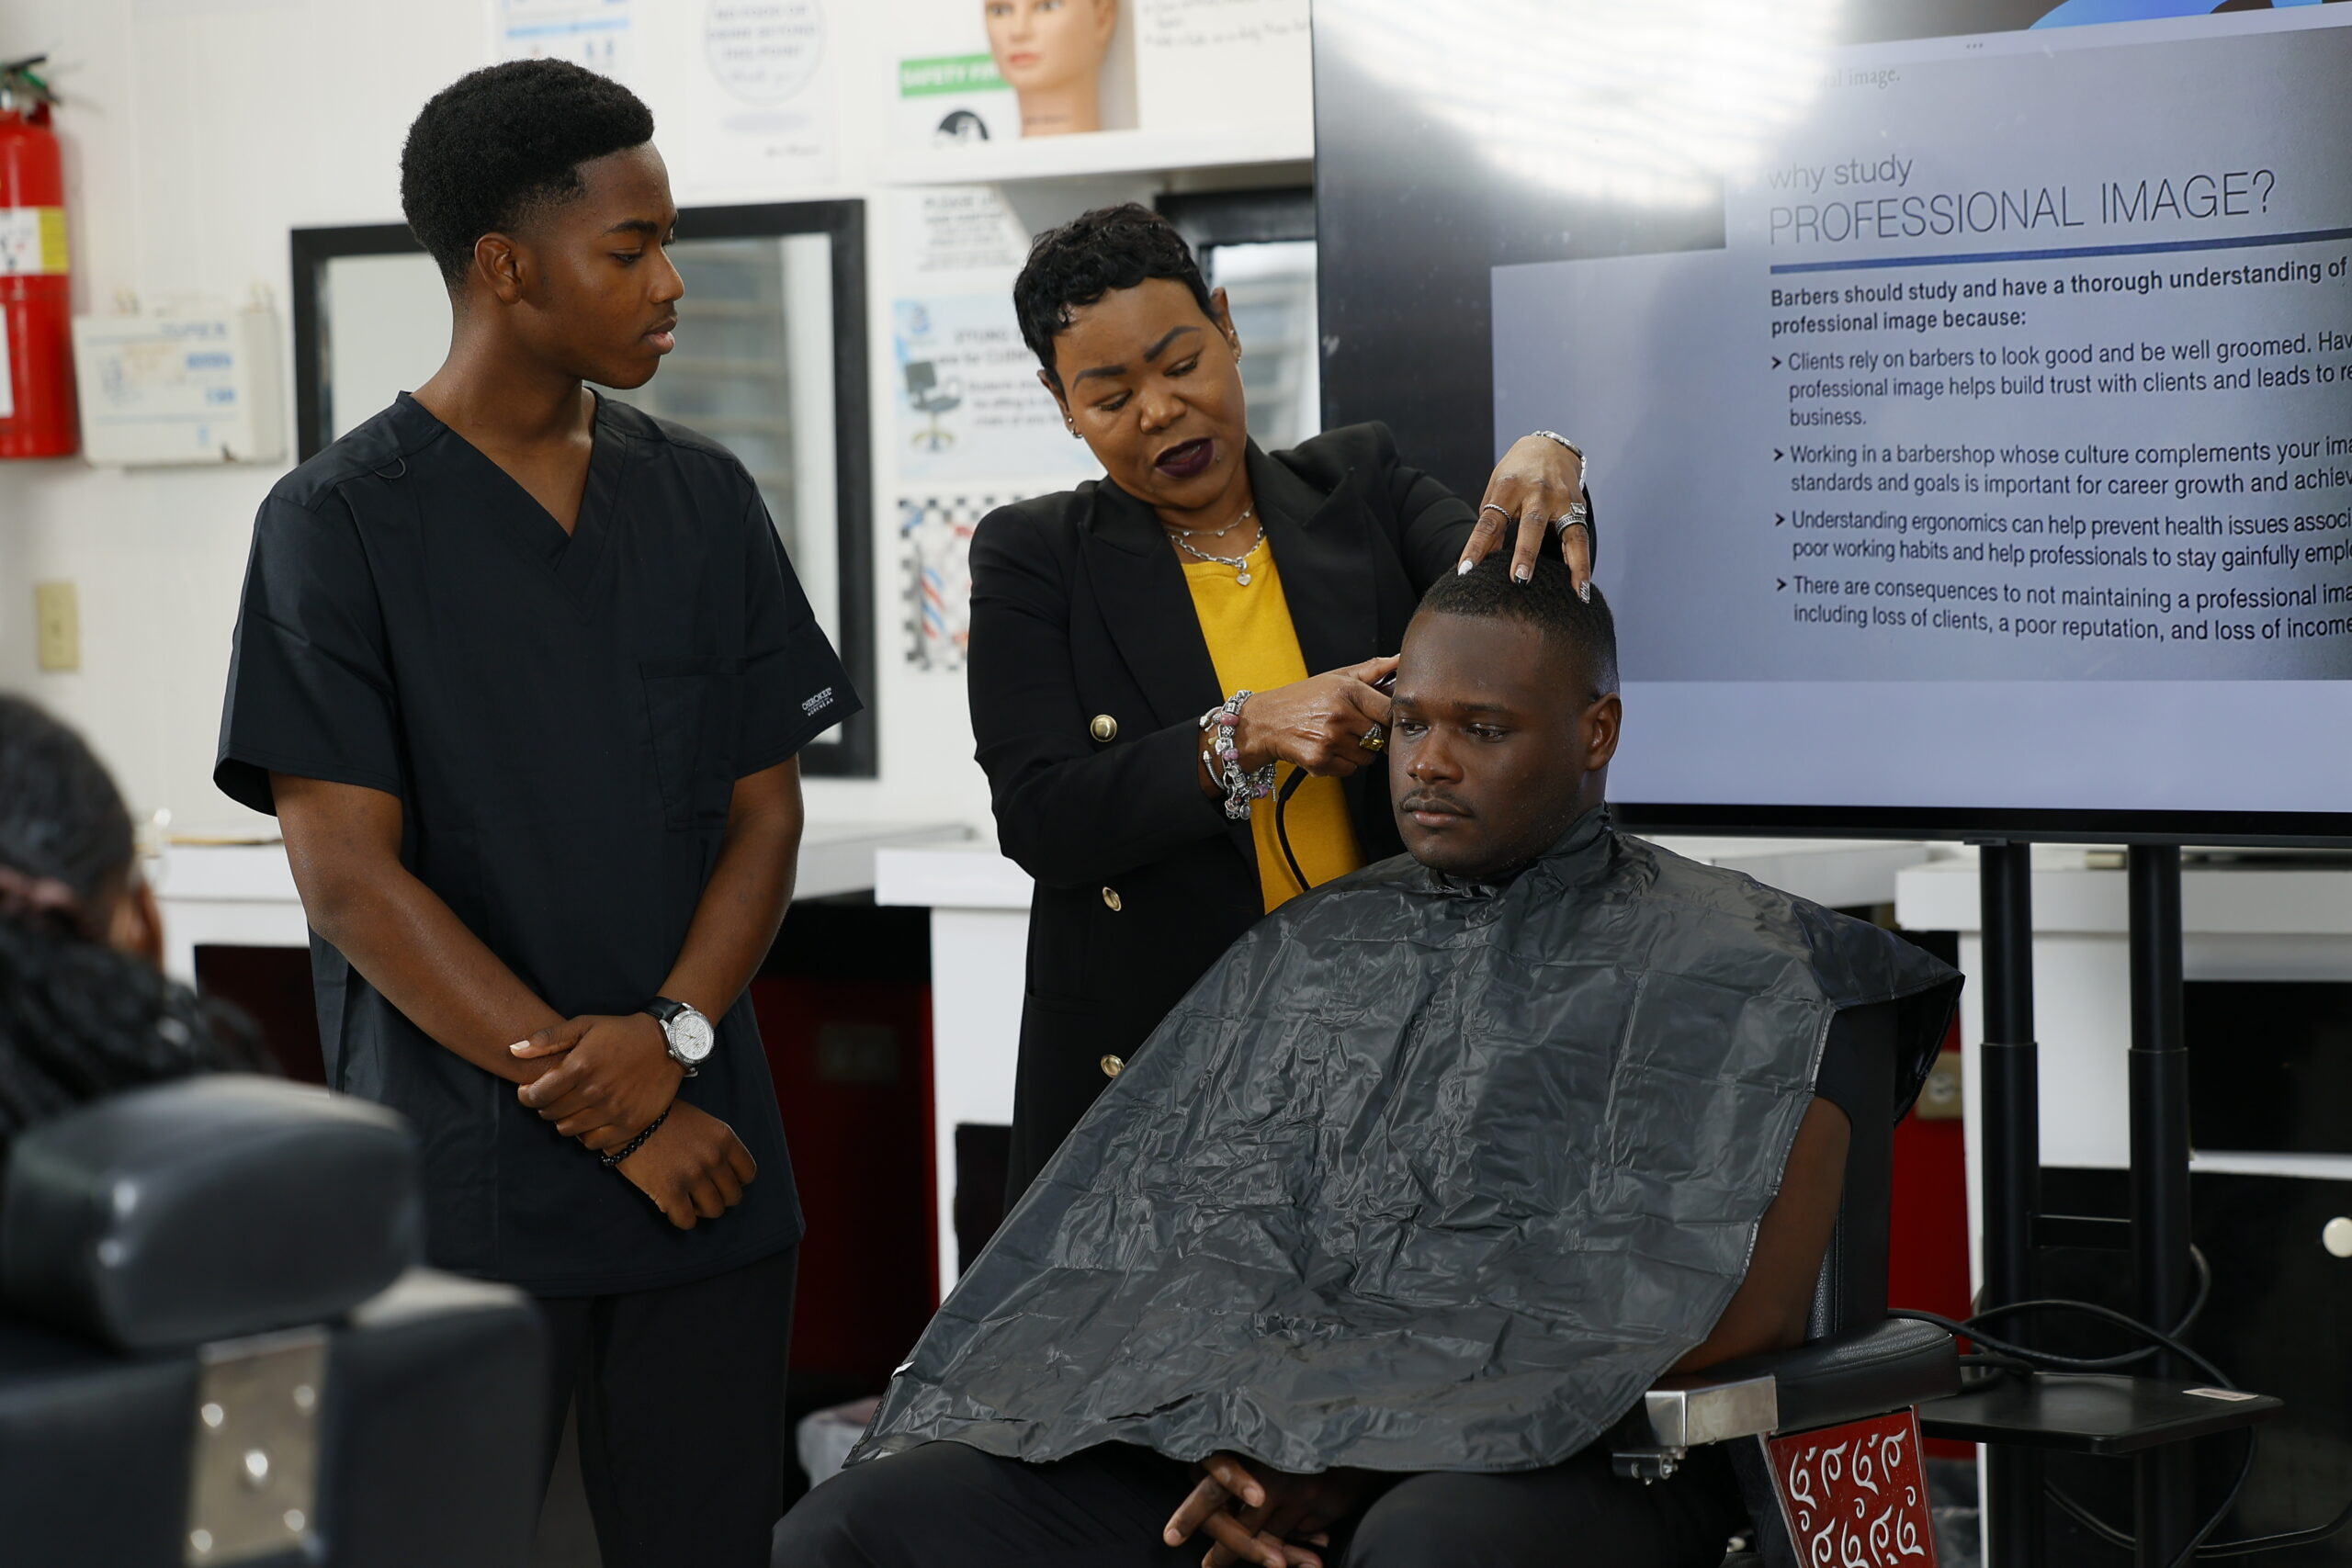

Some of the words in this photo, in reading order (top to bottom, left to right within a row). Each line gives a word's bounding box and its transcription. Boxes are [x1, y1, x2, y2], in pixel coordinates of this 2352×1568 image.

[903, 64, 966, 88] SAFETY
[1849, 69, 1900, 89] image.
[1770, 164, 1826, 195] why
[1835, 153, 1913, 186] study
[1771, 186, 2085, 243] PROFESSIONAL
[2103, 170, 2274, 223] IMAGE?
[1771, 288, 1838, 307] Barbers
[1845, 283, 1903, 303] should
[1909, 281, 1957, 302] study
[1963, 278, 1996, 298] and
[2003, 278, 2047, 296] have
[2053, 280, 2064, 294] a
[2071, 270, 2162, 294] thorough
[2170, 261, 2321, 288] understanding
[2328, 256, 2346, 276] of
[1772, 312, 1877, 338] professional
[1883, 312, 1937, 333] image
[1943, 310, 2025, 327] because:
[1789, 353, 1844, 370] Clients
[1849, 351, 1878, 373] rely
[1883, 354, 1904, 367] on
[1910, 348, 1974, 367] barbers
[1980, 348, 1996, 366] to
[2003, 345, 2040, 365] look
[2045, 344, 2092, 369] good
[2099, 343, 2134, 363] and
[2142, 343, 2165, 361] be
[2172, 340, 2210, 360] well
[2217, 333, 2311, 364] groomed.
[2319, 331, 2352, 351] Hav
[1790, 378, 1887, 402] professional
[1894, 378, 1944, 400] image
[1950, 377, 1996, 399] helps
[2001, 375, 2043, 394] build
[2051, 375, 2091, 393] trust
[2098, 373, 2136, 392] with
[2143, 372, 2207, 391] clients
[2213, 368, 2250, 389] and
[2258, 365, 2310, 387] leads
[2316, 364, 2335, 382] to
[1790, 408, 1866, 426] business.
[1791, 445, 1857, 468] Working
[1862, 445, 1876, 462] in
[1883, 449, 1891, 462] a
[1897, 445, 1995, 468] barbershop
[2000, 445, 2059, 464] whose
[2065, 445, 2129, 464] culture
[2135, 443, 2270, 468] complements
[2277, 442, 2320, 465] your
[1792, 473, 1872, 491] standards
[1878, 473, 1908, 491] and
[1914, 473, 1960, 496] goals
[1965, 473, 1979, 492] is
[1984, 474, 2070, 497] important
[2077, 475, 2102, 494] for
[2108, 479, 2168, 494] career
[2175, 473, 2244, 499] growth
[2251, 470, 2288, 491] and
[1792, 511, 1907, 534] Understanding
[1912, 513, 2007, 535] ergonomics
[2012, 519, 2043, 533] can
[2049, 515, 2086, 539] help
[2092, 517, 2159, 540] prevent
[2165, 515, 2222, 536] health
[2229, 515, 2289, 535] issues
[2294, 507, 2351, 532] associ
[1793, 543, 1829, 560] poor
[1833, 539, 1895, 562] working
[1900, 540, 1949, 559] habits
[1953, 543, 1984, 561] and
[1989, 543, 2025, 567] help
[2030, 545, 2147, 568] professionals
[2153, 547, 2171, 566] to
[2177, 548, 2216, 571] stay
[2222, 545, 2300, 571] gainfully
[2305, 538, 2352, 565] empl
[1793, 576, 1839, 594] There
[1845, 581, 1870, 595] are
[1874, 582, 1997, 603] consequences
[2004, 584, 2020, 603] to
[2027, 586, 2055, 604] not
[2063, 587, 2171, 613] maintaining
[2178, 593, 2189, 608] a
[2197, 584, 2316, 614] professional
[1794, 604, 1868, 628] including
[1873, 606, 1906, 626] loss
[1911, 608, 1928, 626] of
[1933, 609, 1992, 633] clients,
[1999, 617, 2008, 631] a
[2015, 618, 2056, 637] poor
[2063, 618, 2164, 642] reputation,
[2172, 620, 2208, 639] and
[2215, 620, 2255, 639] loss
[2262, 618, 2280, 638] of
[802, 687, 831, 711] CHEROKEE
